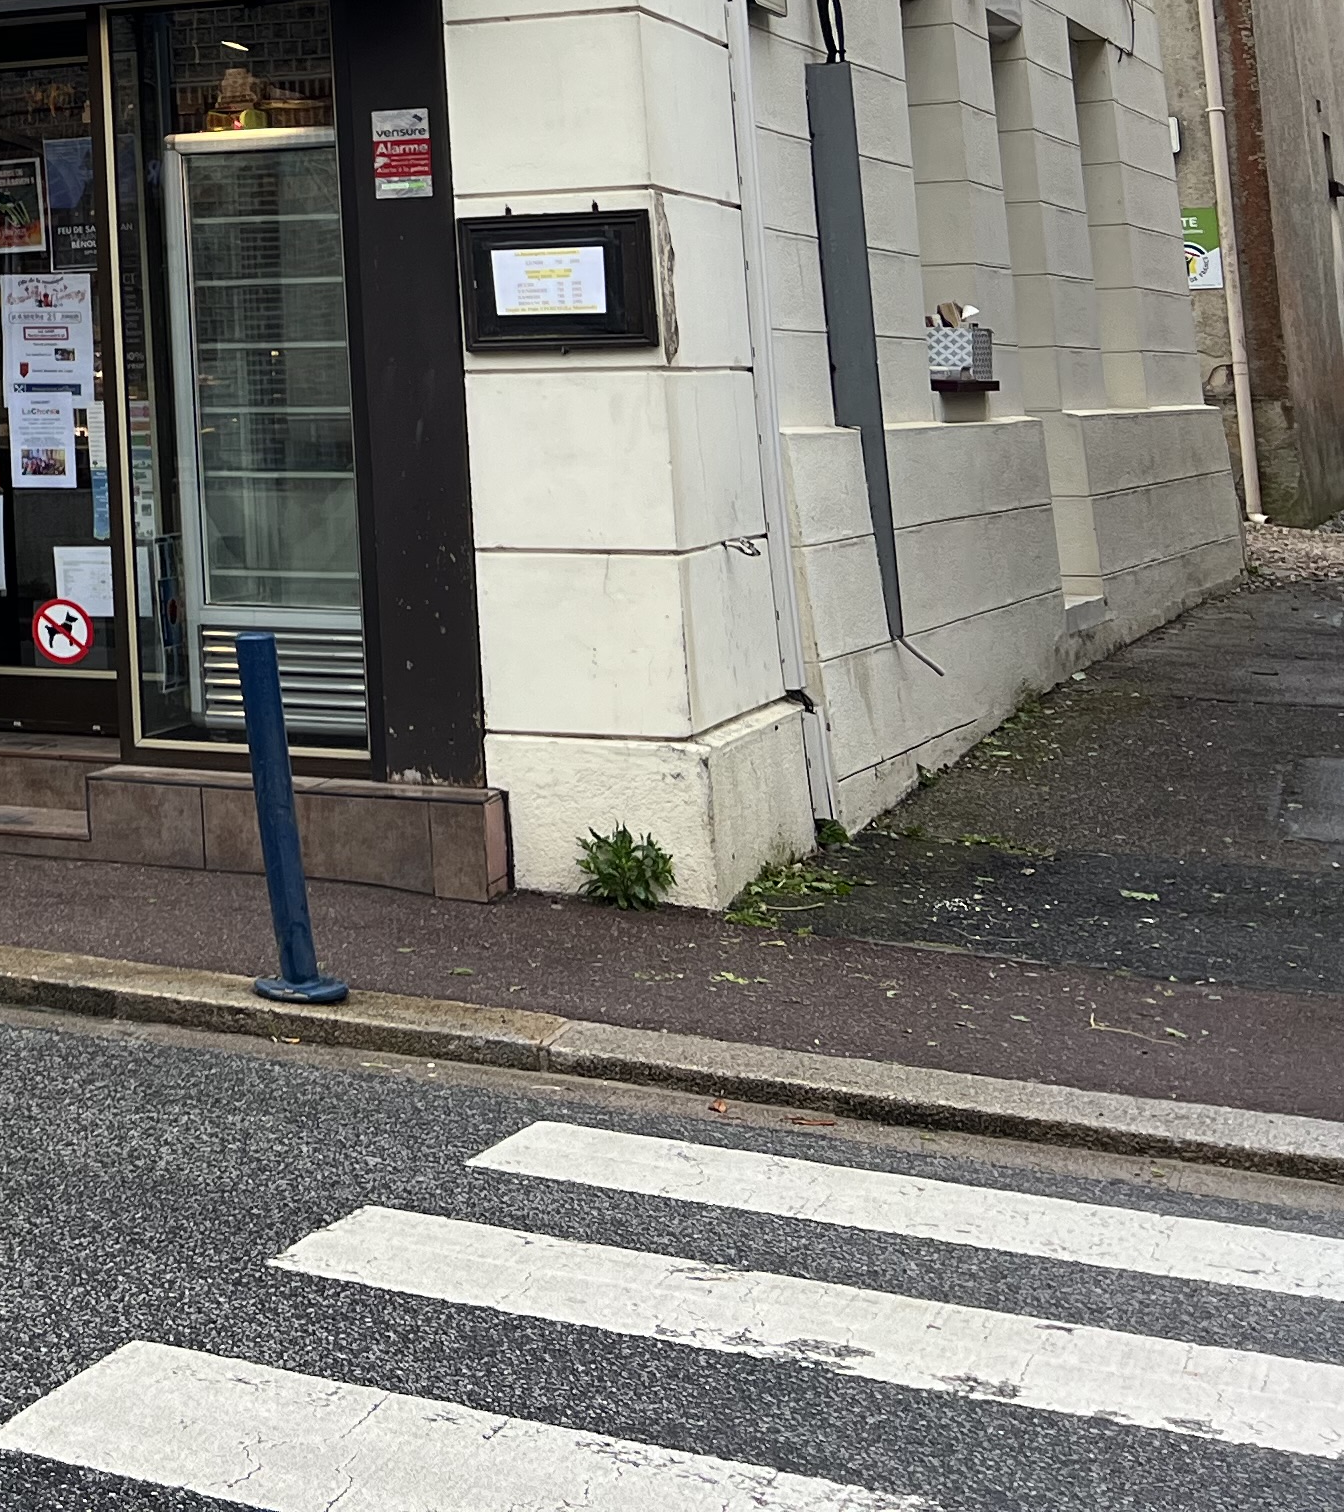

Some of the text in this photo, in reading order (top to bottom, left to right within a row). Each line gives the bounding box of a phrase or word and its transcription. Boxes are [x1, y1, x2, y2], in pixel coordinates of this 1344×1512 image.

[376, 141, 428, 155] Alarme
[57, 226, 72, 236] FEU
[73, 225, 84, 235] DE
[85, 224, 96, 234] SA
